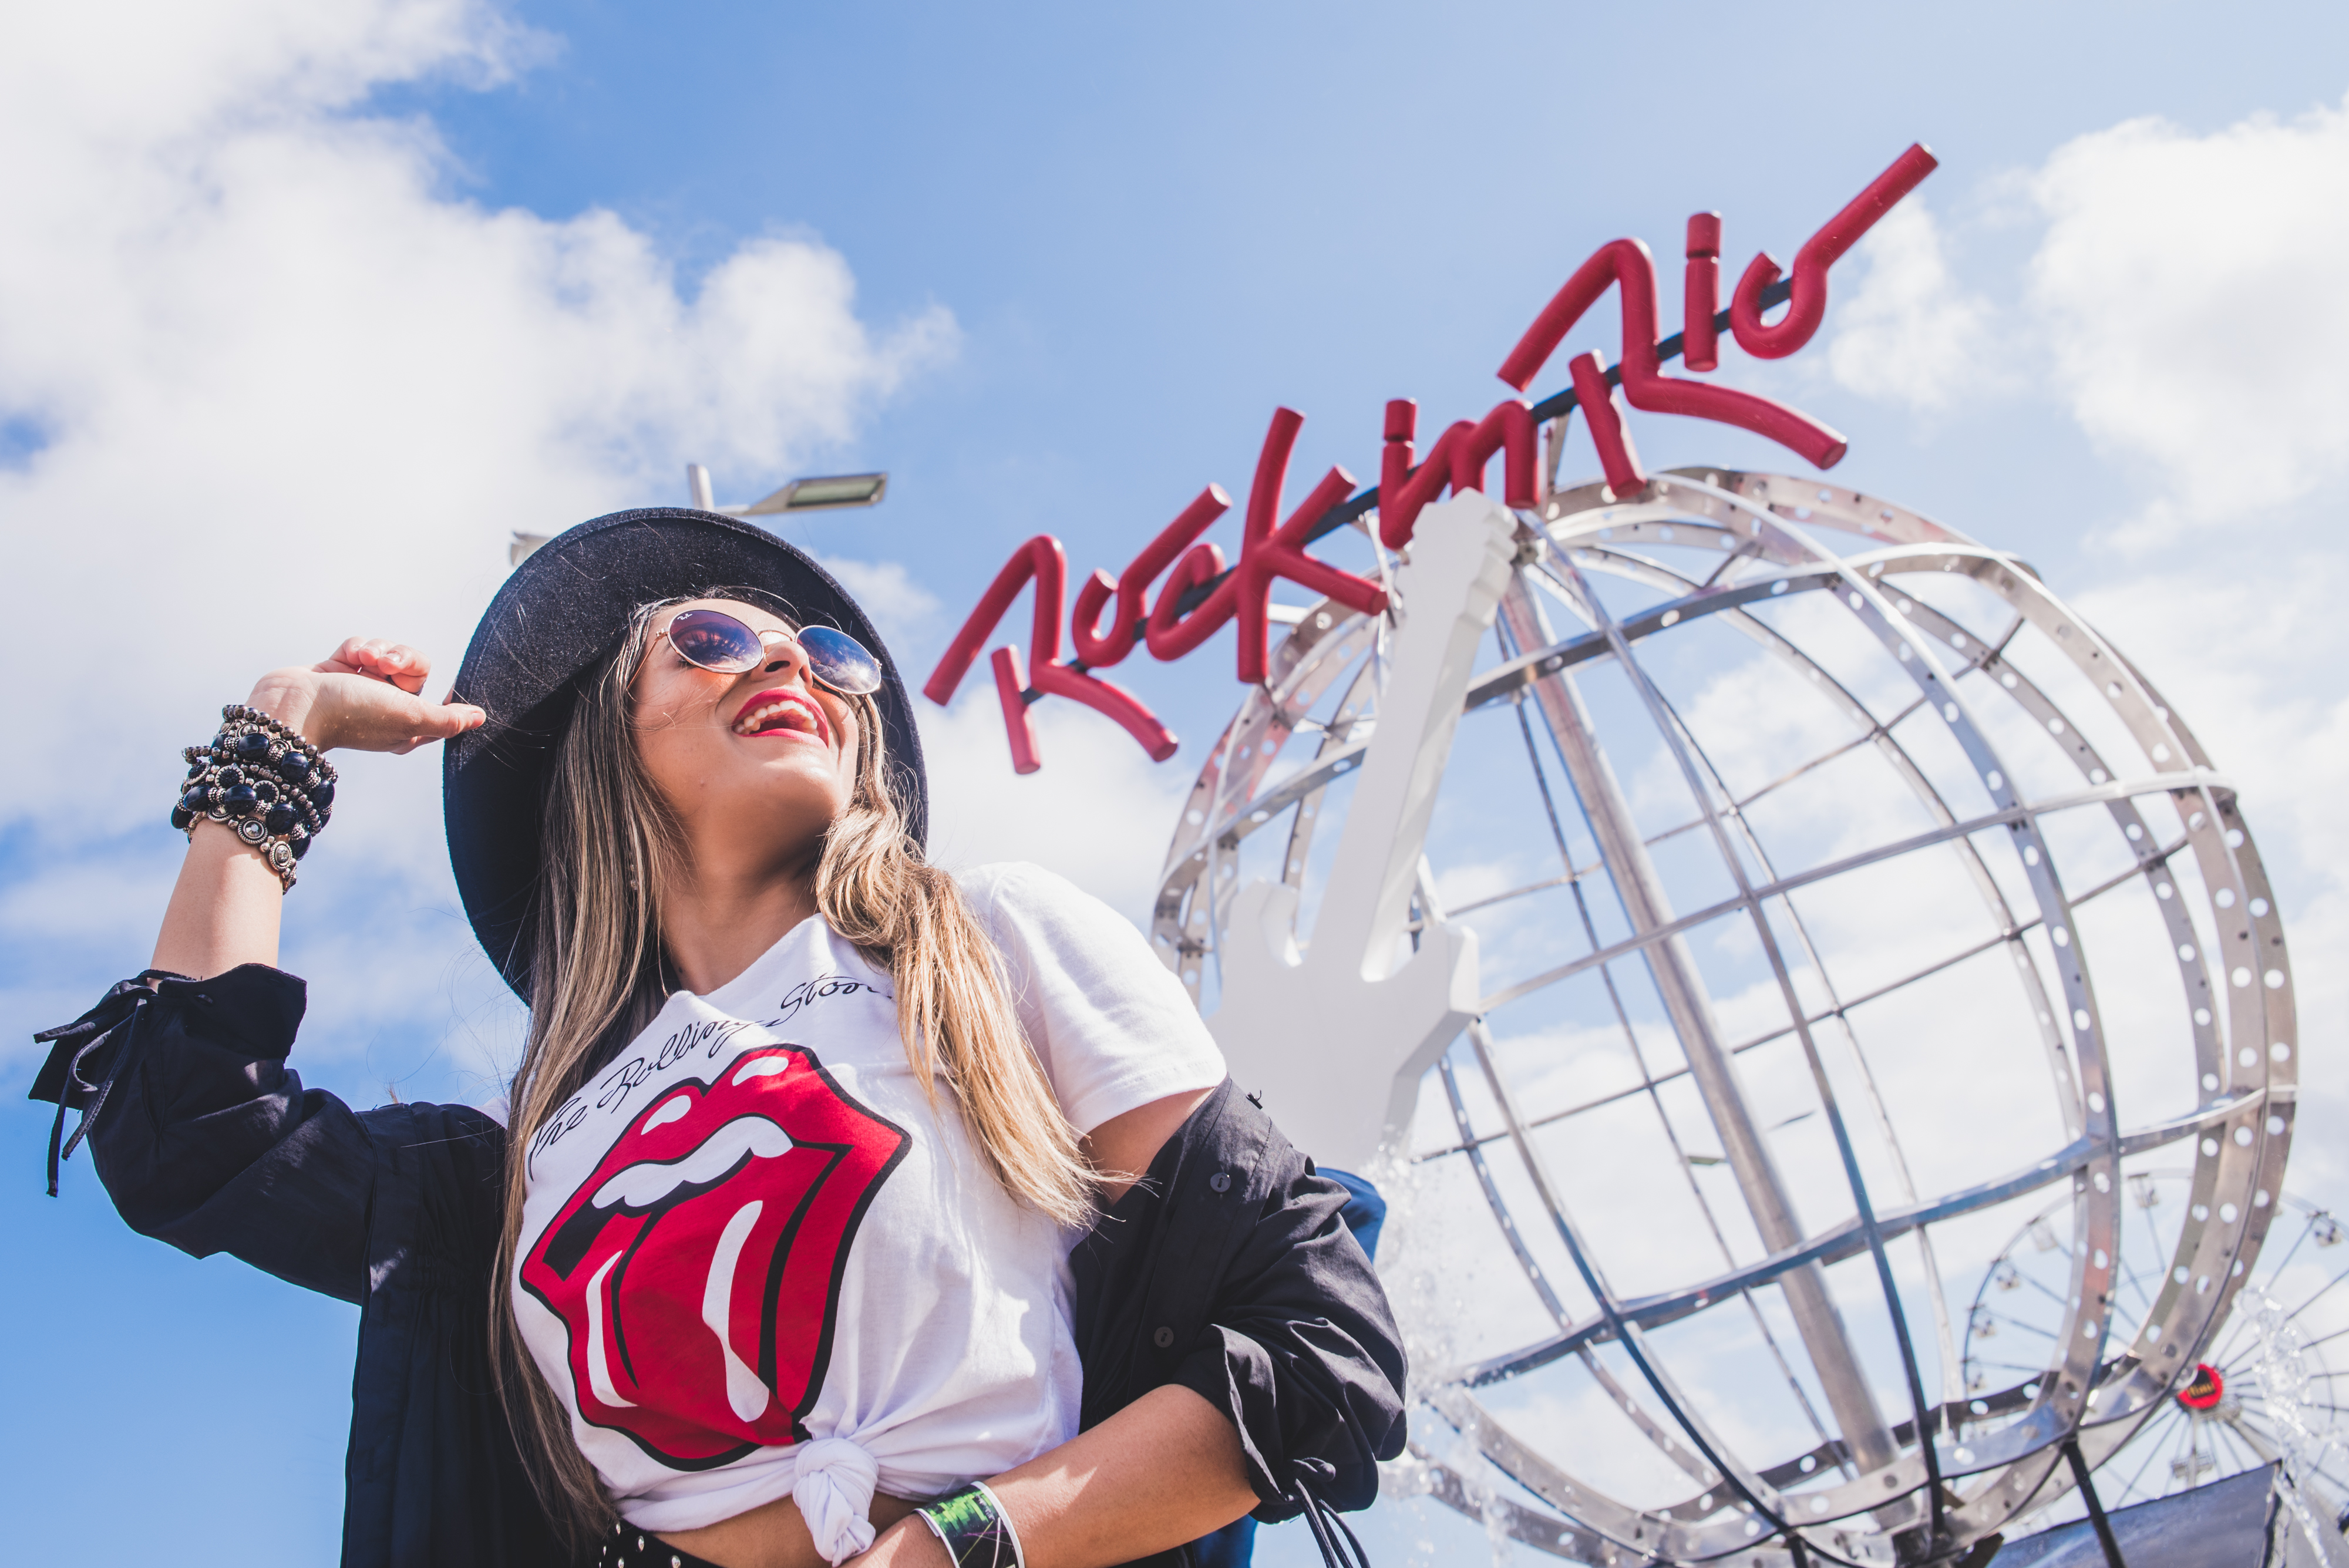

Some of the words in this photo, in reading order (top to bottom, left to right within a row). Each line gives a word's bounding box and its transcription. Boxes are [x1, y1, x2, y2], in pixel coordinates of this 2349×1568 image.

[923, 406, 1389, 774] Rock
[1379, 398, 1540, 551] in
[1497, 142, 1939, 497] Rio
[596, 1021, 764, 1114] Rolling
